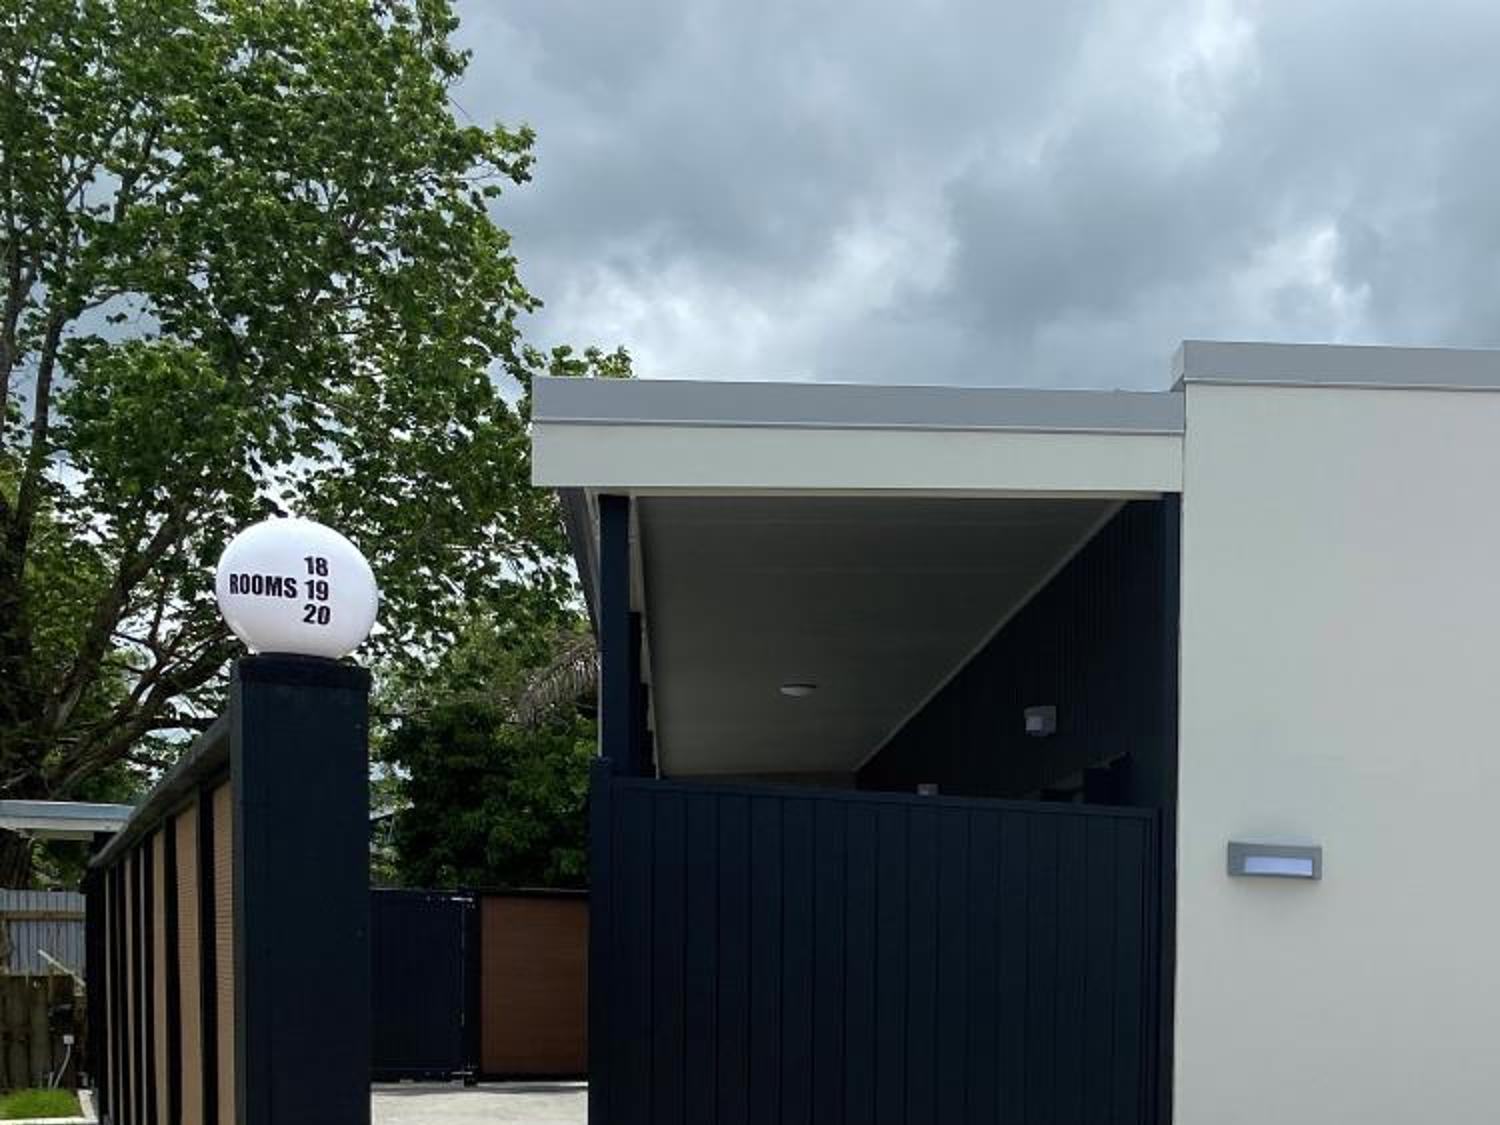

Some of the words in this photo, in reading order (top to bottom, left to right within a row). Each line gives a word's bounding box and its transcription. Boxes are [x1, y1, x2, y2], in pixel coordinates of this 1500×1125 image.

[303, 556, 329, 577] 18
[229, 573, 298, 599] ROOMS
[303, 579, 329, 601] 19
[303, 604, 331, 625] 20
